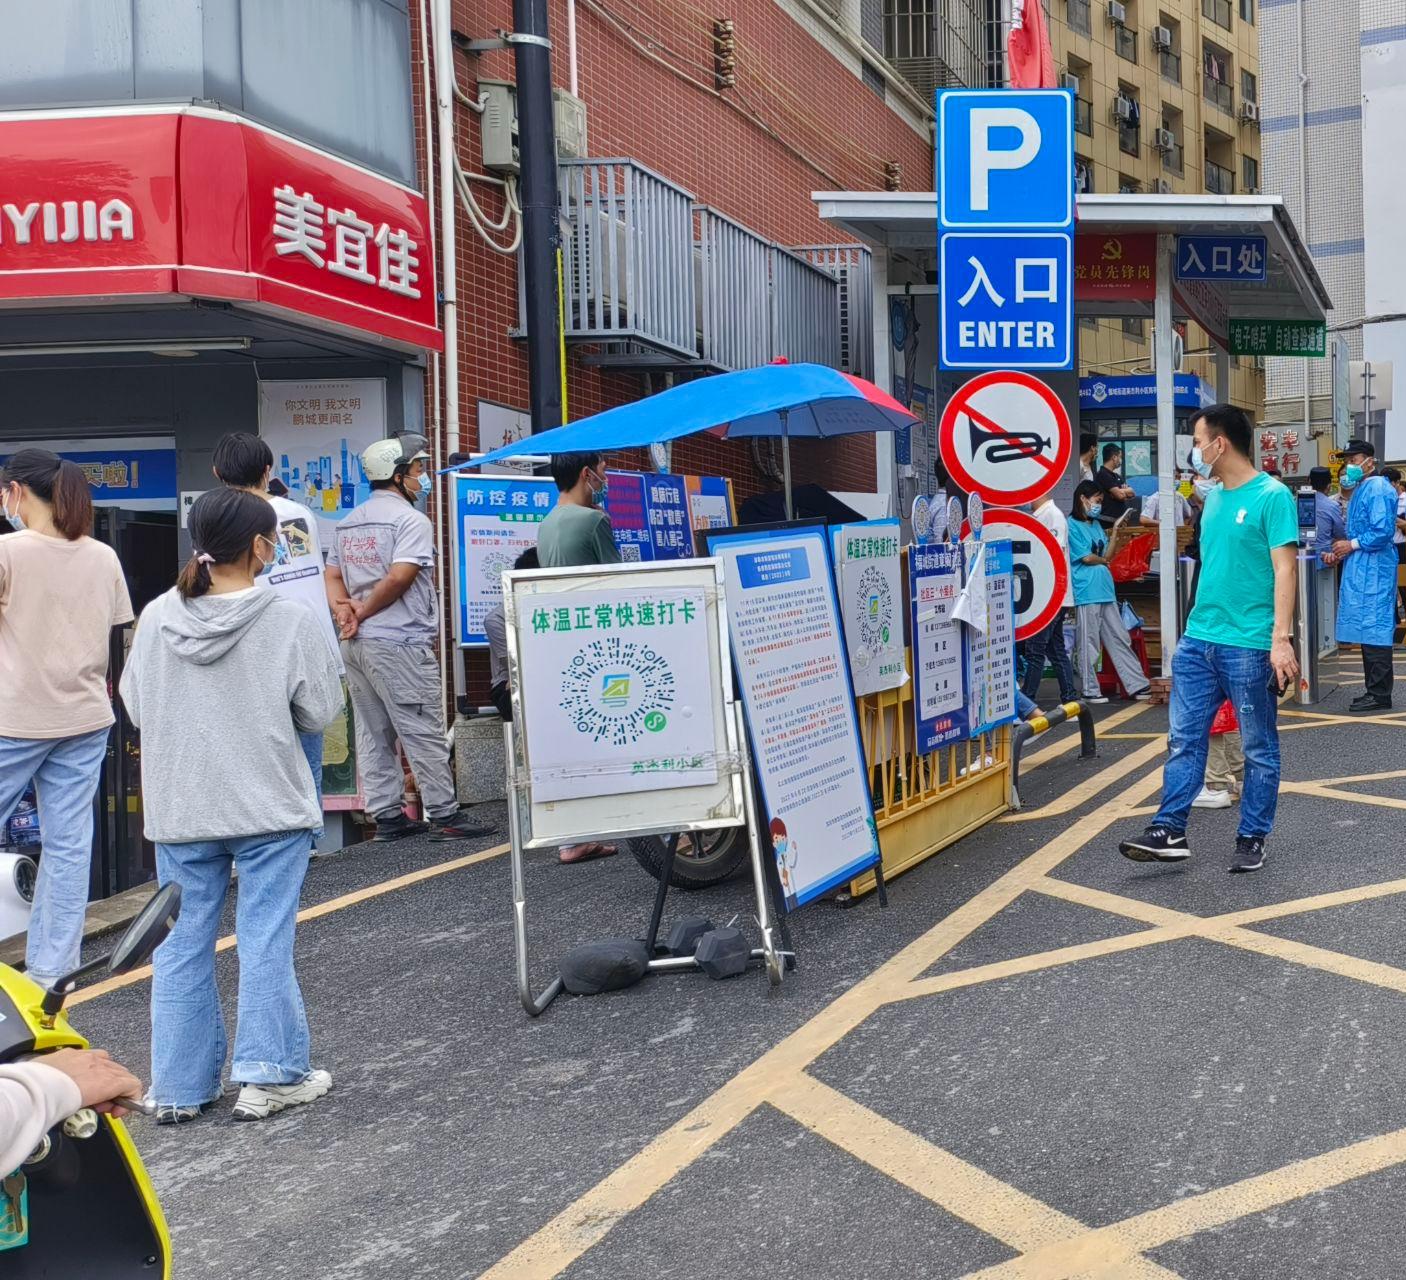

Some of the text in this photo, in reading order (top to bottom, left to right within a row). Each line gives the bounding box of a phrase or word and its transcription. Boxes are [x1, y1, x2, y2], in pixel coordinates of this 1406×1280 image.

[969, 107, 1042, 211] P
[0, 199, 134, 244] YIJIA
[273, 184, 421, 299] 美宜佳
[1074, 265, 1150, 279] 党员先锋岗
[1182, 244, 1263, 274] 入口处
[958, 256, 1058, 307] 入口
[958, 321, 1055, 348] ENTER
[285, 398, 361, 411] 你文明 我文明
[292, 413, 354, 425] 鹏城更闻名
[467, 489, 550, 507] 防控疫情
[847, 535, 899, 560] 体温正常快速打卡
[531, 599, 696, 633] 体温正常快速打卡
